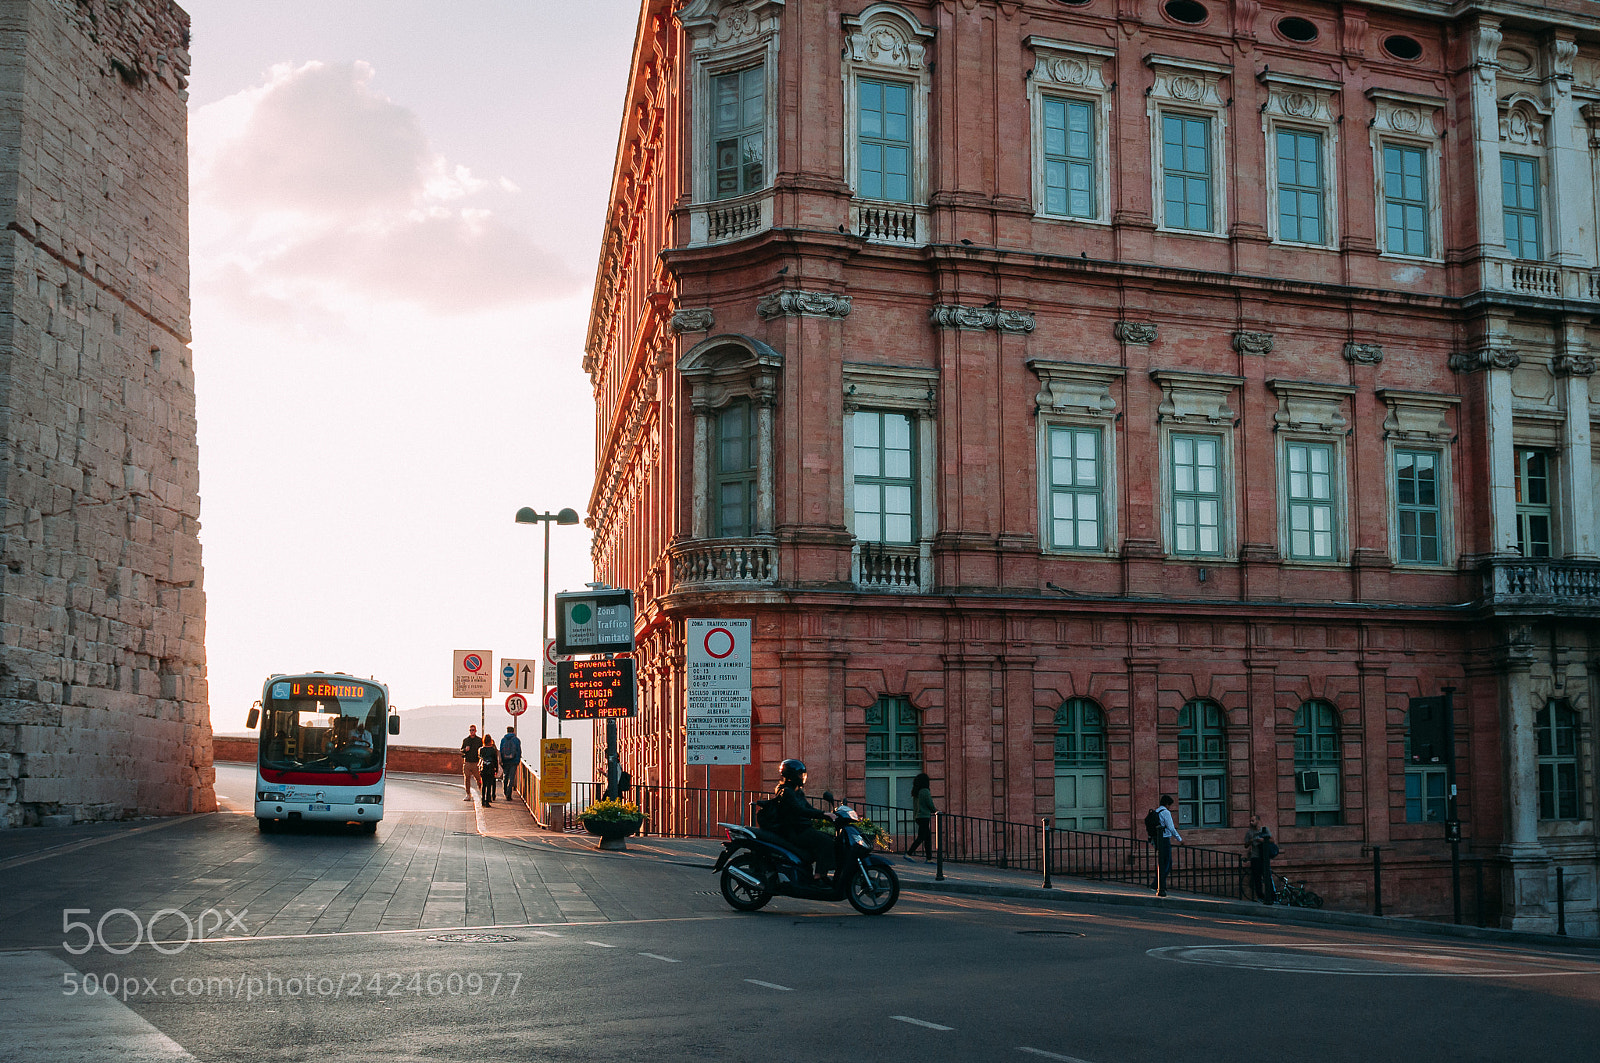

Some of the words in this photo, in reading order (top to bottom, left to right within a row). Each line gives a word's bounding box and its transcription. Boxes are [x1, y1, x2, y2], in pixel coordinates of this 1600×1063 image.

[597, 607, 615, 616] Zona
[597, 620, 628, 629] Traffico
[598, 633, 630, 642] Limitato
[573, 660, 616, 670] Benvenuti
[569, 670, 584, 679] nel
[592, 669, 622, 678] centro
[569, 680, 603, 689] storico
[611, 678, 621, 687] di
[293, 683, 301, 695] U
[307, 683, 364, 698] S.ERMINIO
[579, 688, 613, 699] PERUGIA
[510, 698, 522, 711] 30
[584, 698, 609, 708] 18:07
[565, 709, 593, 719] Z.T.L.
[598, 707, 628, 717] APERTA
